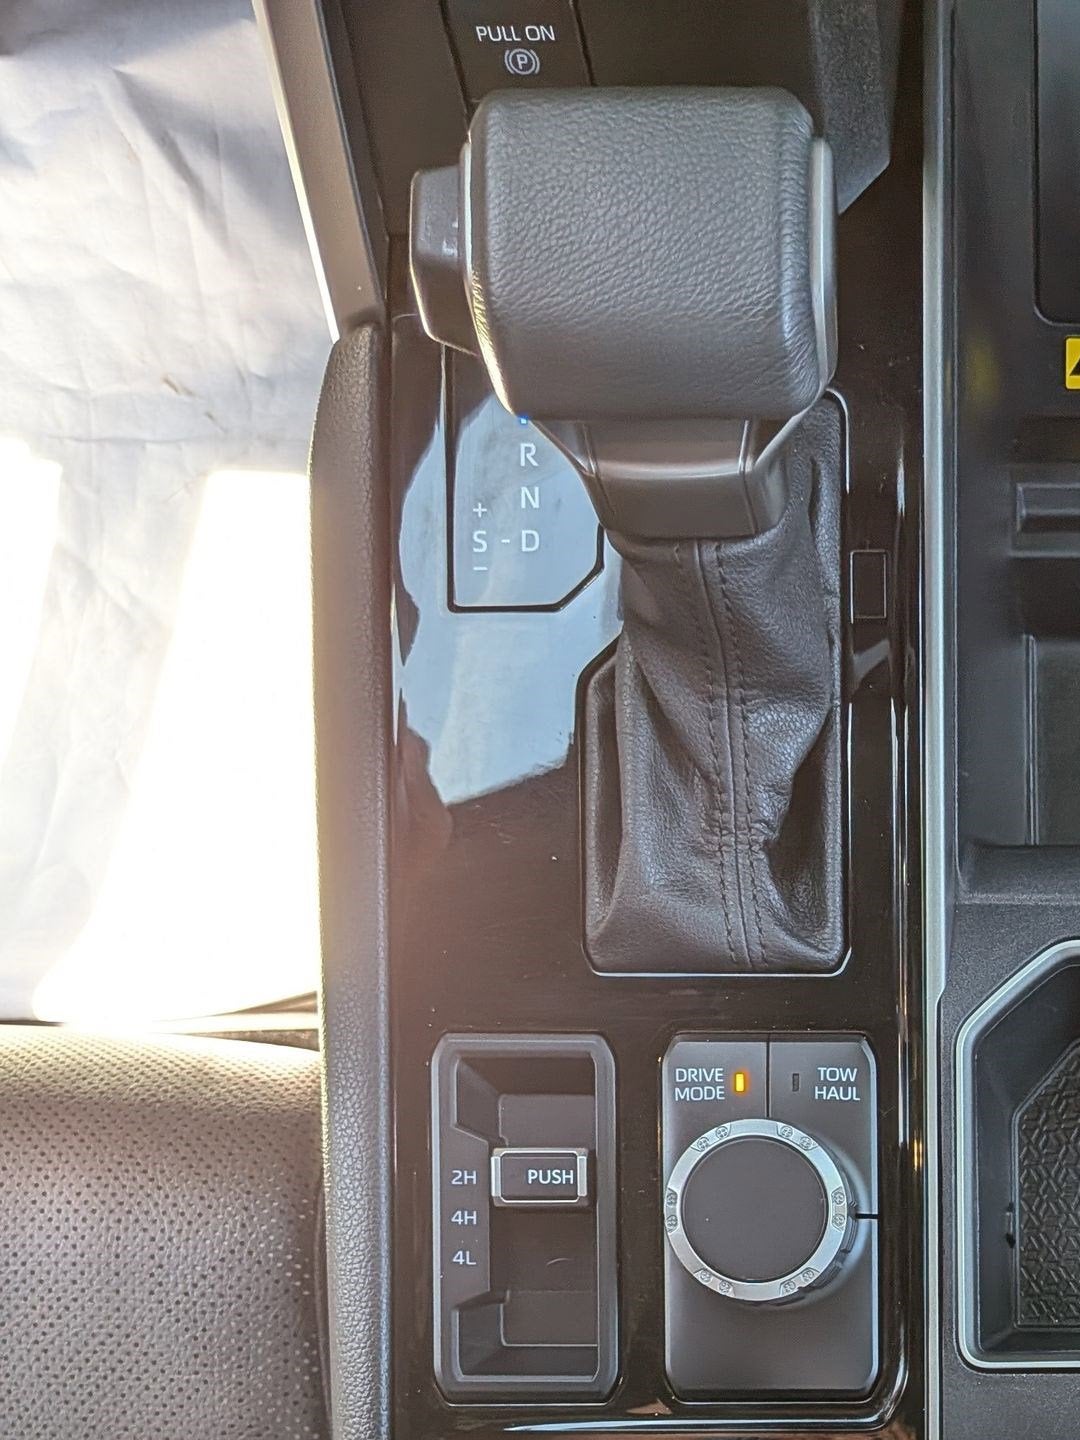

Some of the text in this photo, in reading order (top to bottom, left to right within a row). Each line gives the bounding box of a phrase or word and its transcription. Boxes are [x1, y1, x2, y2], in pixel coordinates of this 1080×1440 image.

[475, 25, 556, 42] PULL ON
[519, 443, 540, 467] R
[520, 486, 540, 509] N
[472, 530, 488, 553] S
[521, 530, 540, 552] D
[675, 1068, 724, 1083] DRIVE
[817, 1067, 858, 1082] TOW
[674, 1086, 726, 1101] MODE
[814, 1086, 861, 1101] HAUL
[451, 1170, 477, 1185] 2H
[527, 1169, 574, 1185] PUSH
[451, 1210, 477, 1225] 4H
[452, 1251, 477, 1265] 4L
